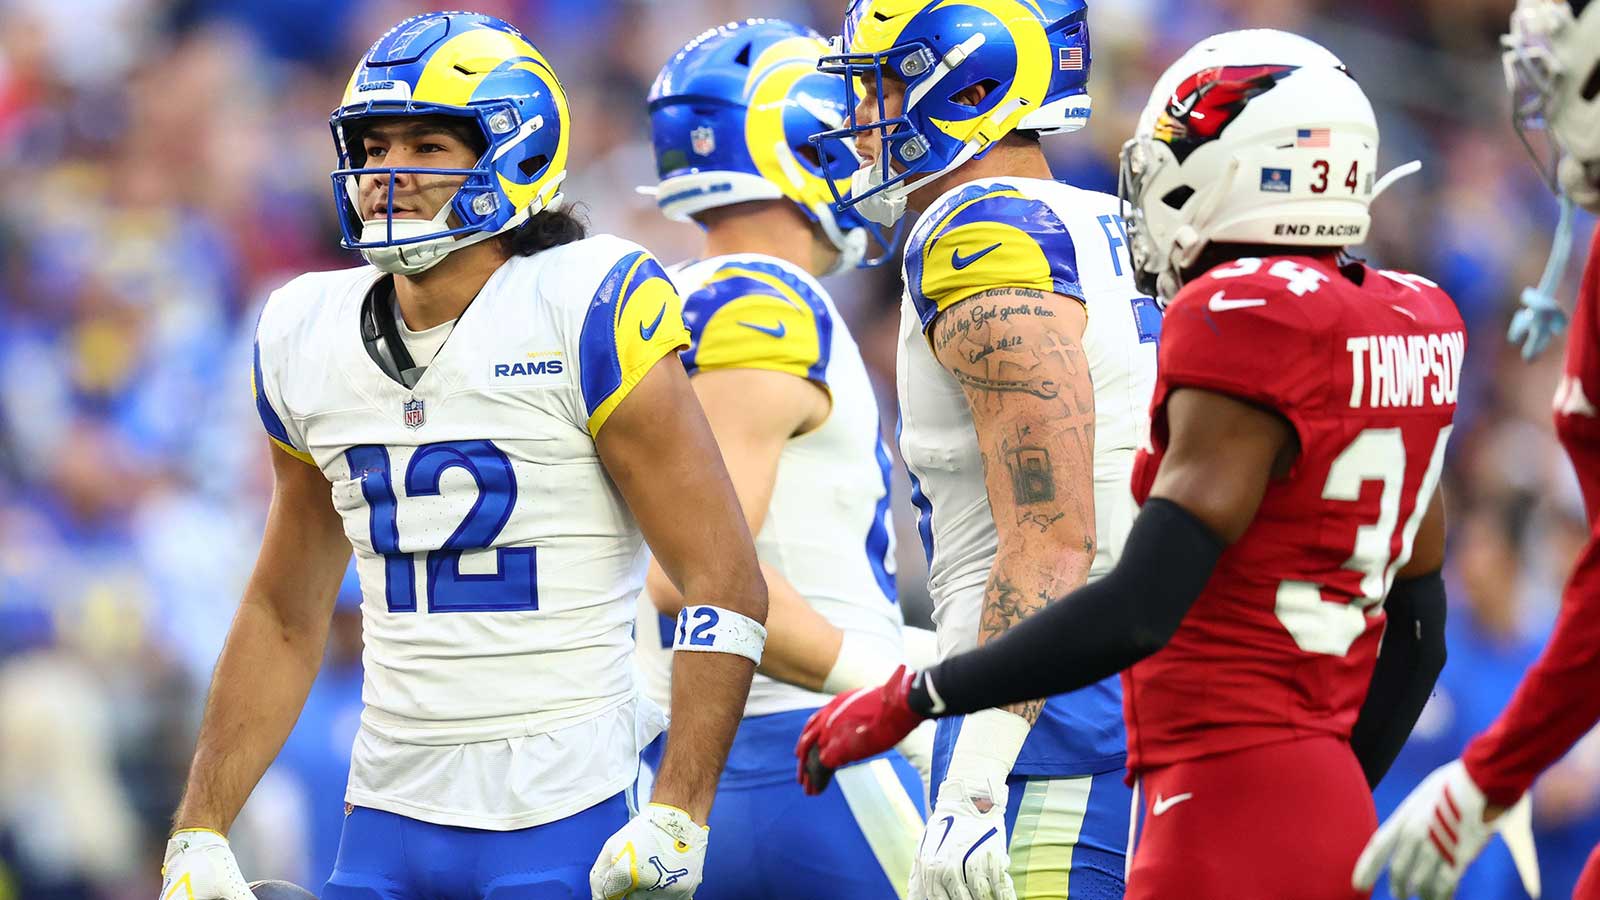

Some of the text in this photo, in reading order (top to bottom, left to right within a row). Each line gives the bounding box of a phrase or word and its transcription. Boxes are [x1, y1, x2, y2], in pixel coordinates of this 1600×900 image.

[358, 81, 395, 92] RAMS
[1274, 224, 1362, 236] END RACISM
[970, 304, 997, 331] God
[996, 335, 1023, 350] 20:12
[494, 360, 563, 377] RAMS
[1345, 331, 1466, 408] THOMPSON
[406, 410, 423, 425] NFL
[344, 438, 539, 613] 12
[678, 606, 720, 646] 12
